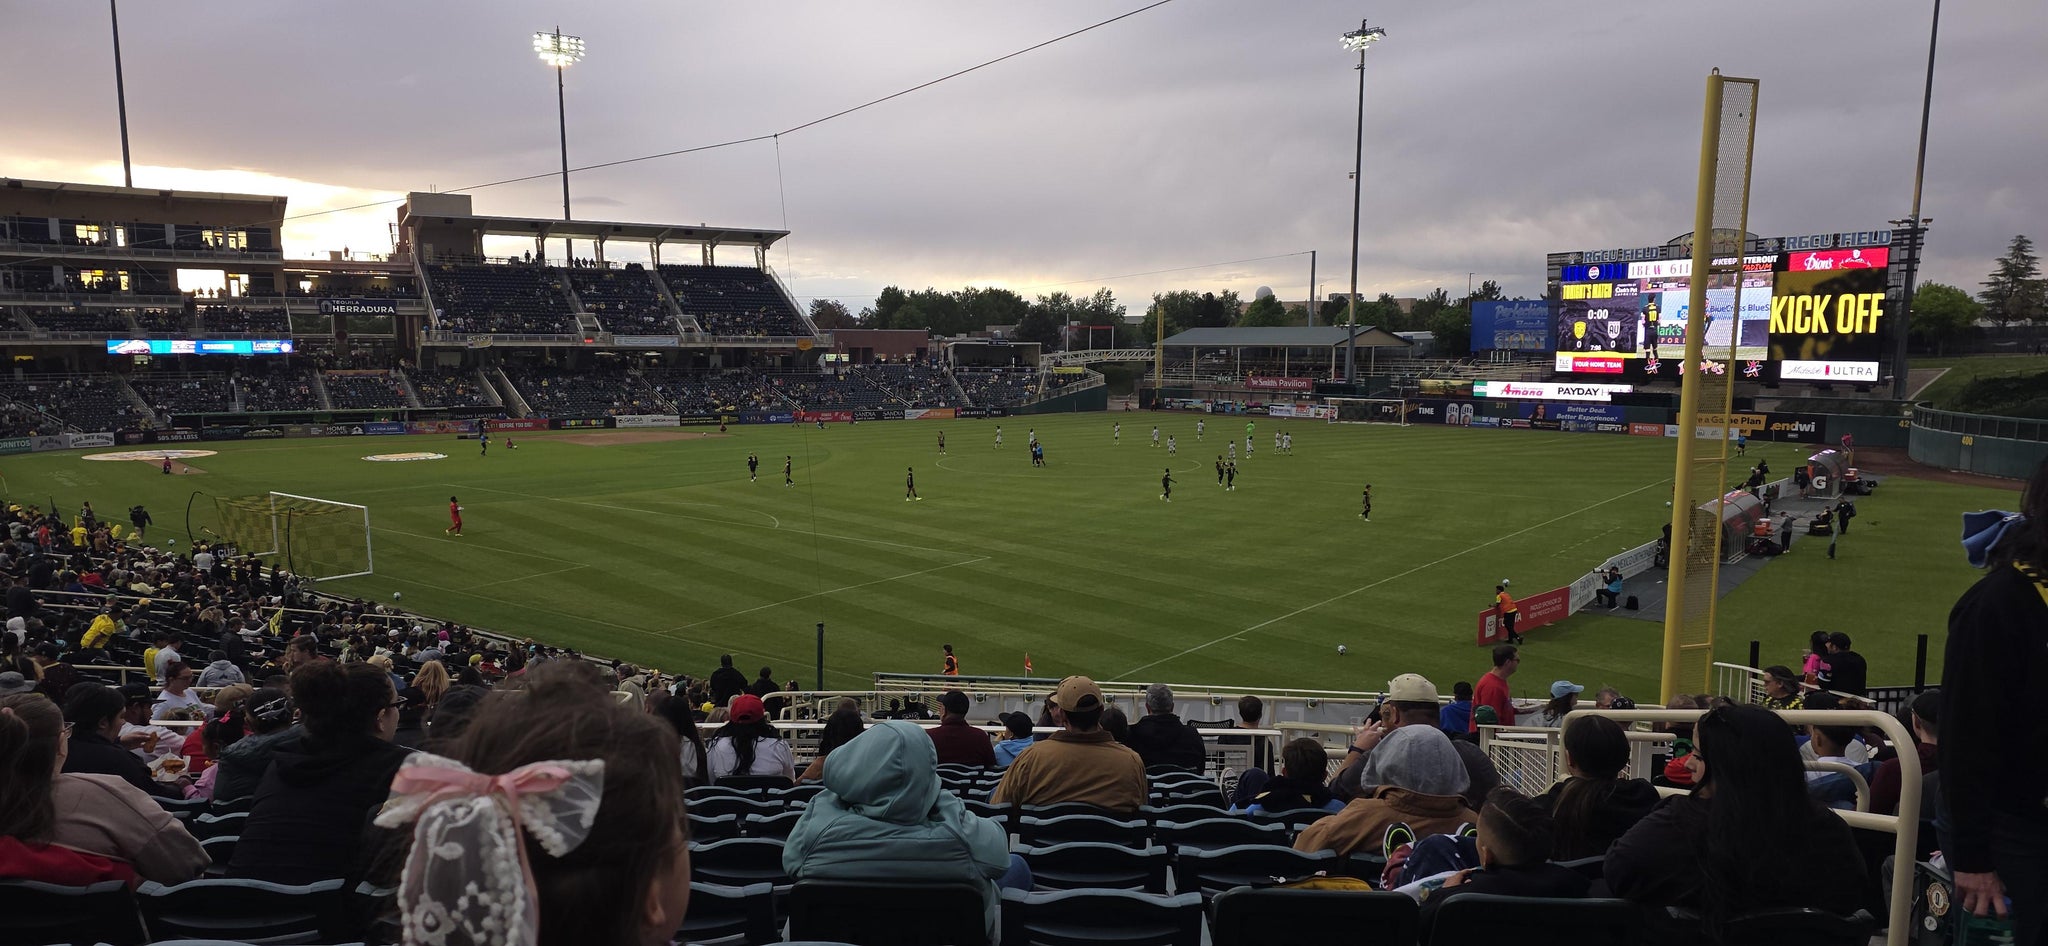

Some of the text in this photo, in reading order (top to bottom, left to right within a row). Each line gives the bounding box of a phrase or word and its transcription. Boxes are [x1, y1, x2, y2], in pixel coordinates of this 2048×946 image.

[1785, 230, 1892, 249] RGCU FIELD
[1583, 247, 1659, 263] RGCU FIELD
[332, 305, 395, 313] HERRADURA
[1769, 293, 1886, 334] KICK OFF
[1588, 309, 1609, 320] 0:00
[1576, 340, 1582, 348] 0
[1610, 340, 1616, 348] 0
[1833, 366, 1873, 376] ULTRA
[1279, 379, 1307, 388] Pavilion
[1501, 383, 1544, 396] Amana
[1558, 387, 1600, 396] PAYDAY
[1419, 407, 1434, 415] TIME
[1740, 417, 1762, 425] Plan
[1962, 436, 1974, 446] 400
